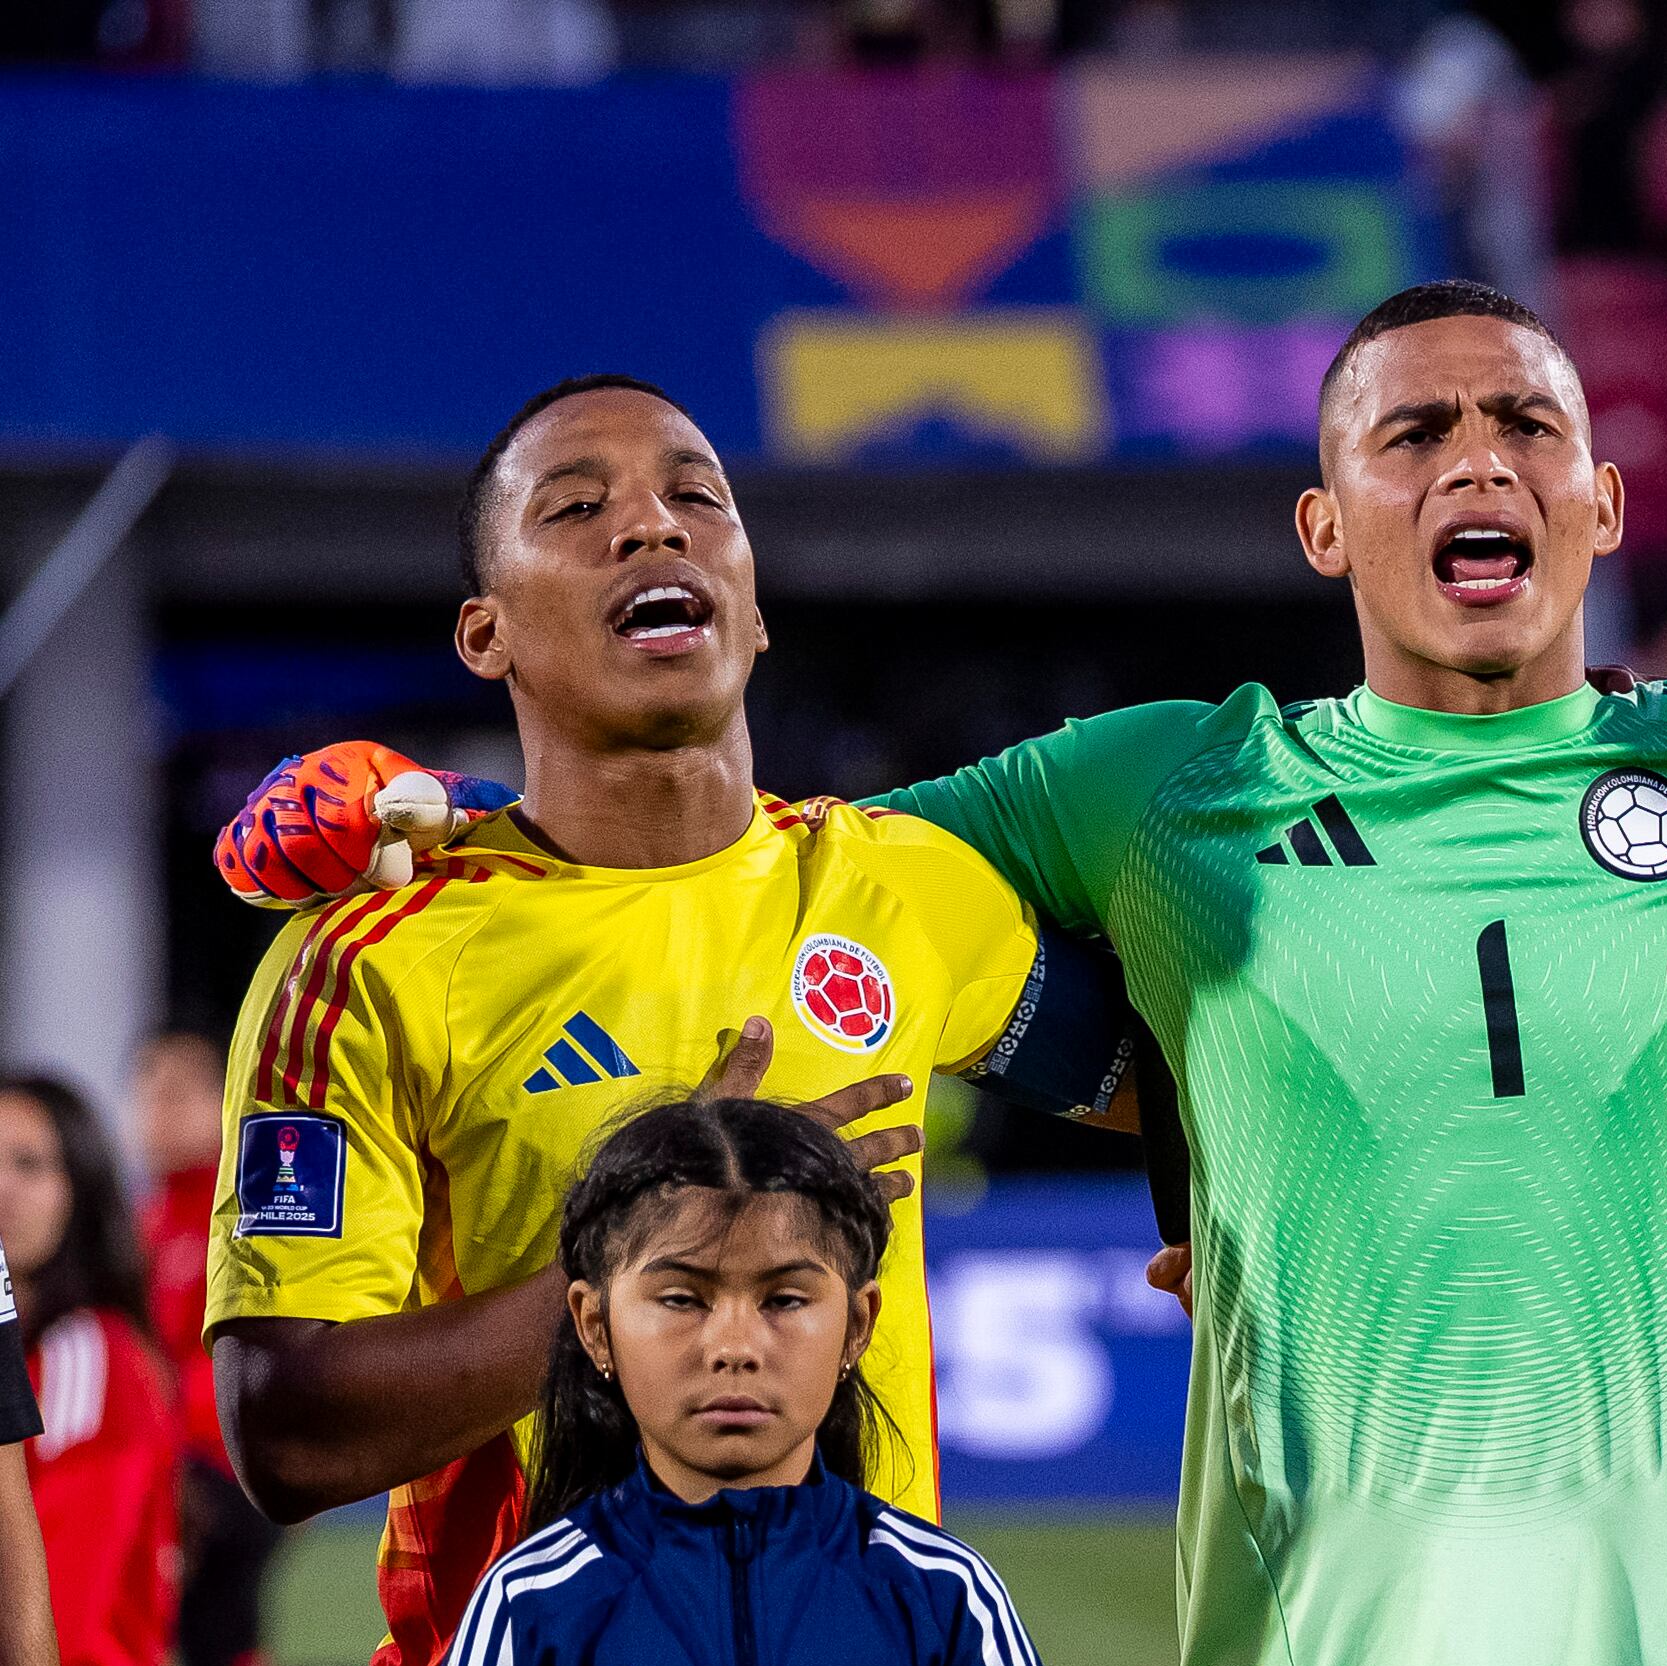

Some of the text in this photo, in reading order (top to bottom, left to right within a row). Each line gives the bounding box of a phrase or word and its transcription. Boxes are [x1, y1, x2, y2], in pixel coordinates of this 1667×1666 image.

[1607, 775, 1658, 788] COLOMBIANA
[1659, 784, 1667, 794] DE
[1476, 919, 1525, 1098] 1
[274, 1195, 295, 1203] FIFA
